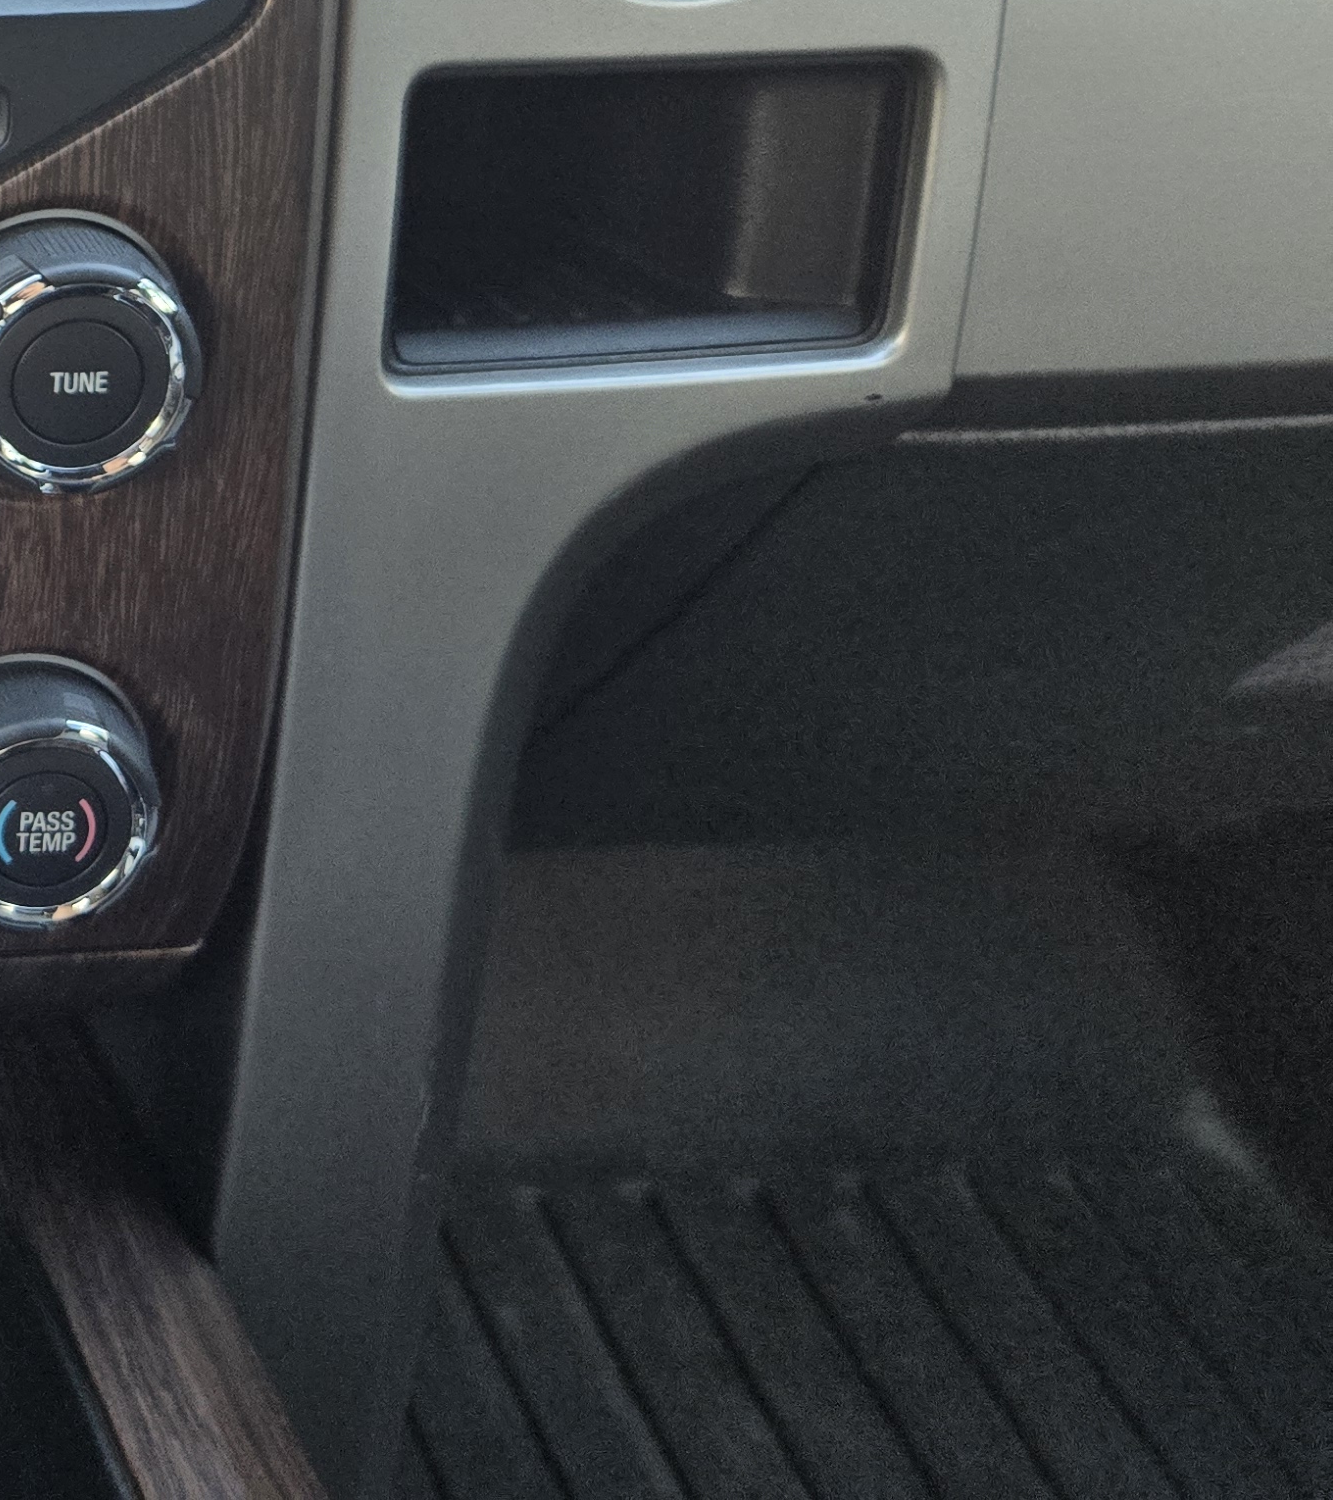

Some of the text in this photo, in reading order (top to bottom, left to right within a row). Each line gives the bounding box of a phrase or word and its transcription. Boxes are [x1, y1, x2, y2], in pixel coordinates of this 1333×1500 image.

[50, 371, 109, 395] TUNE
[19, 810, 76, 833] PASS
[16, 832, 77, 855] TEMP
